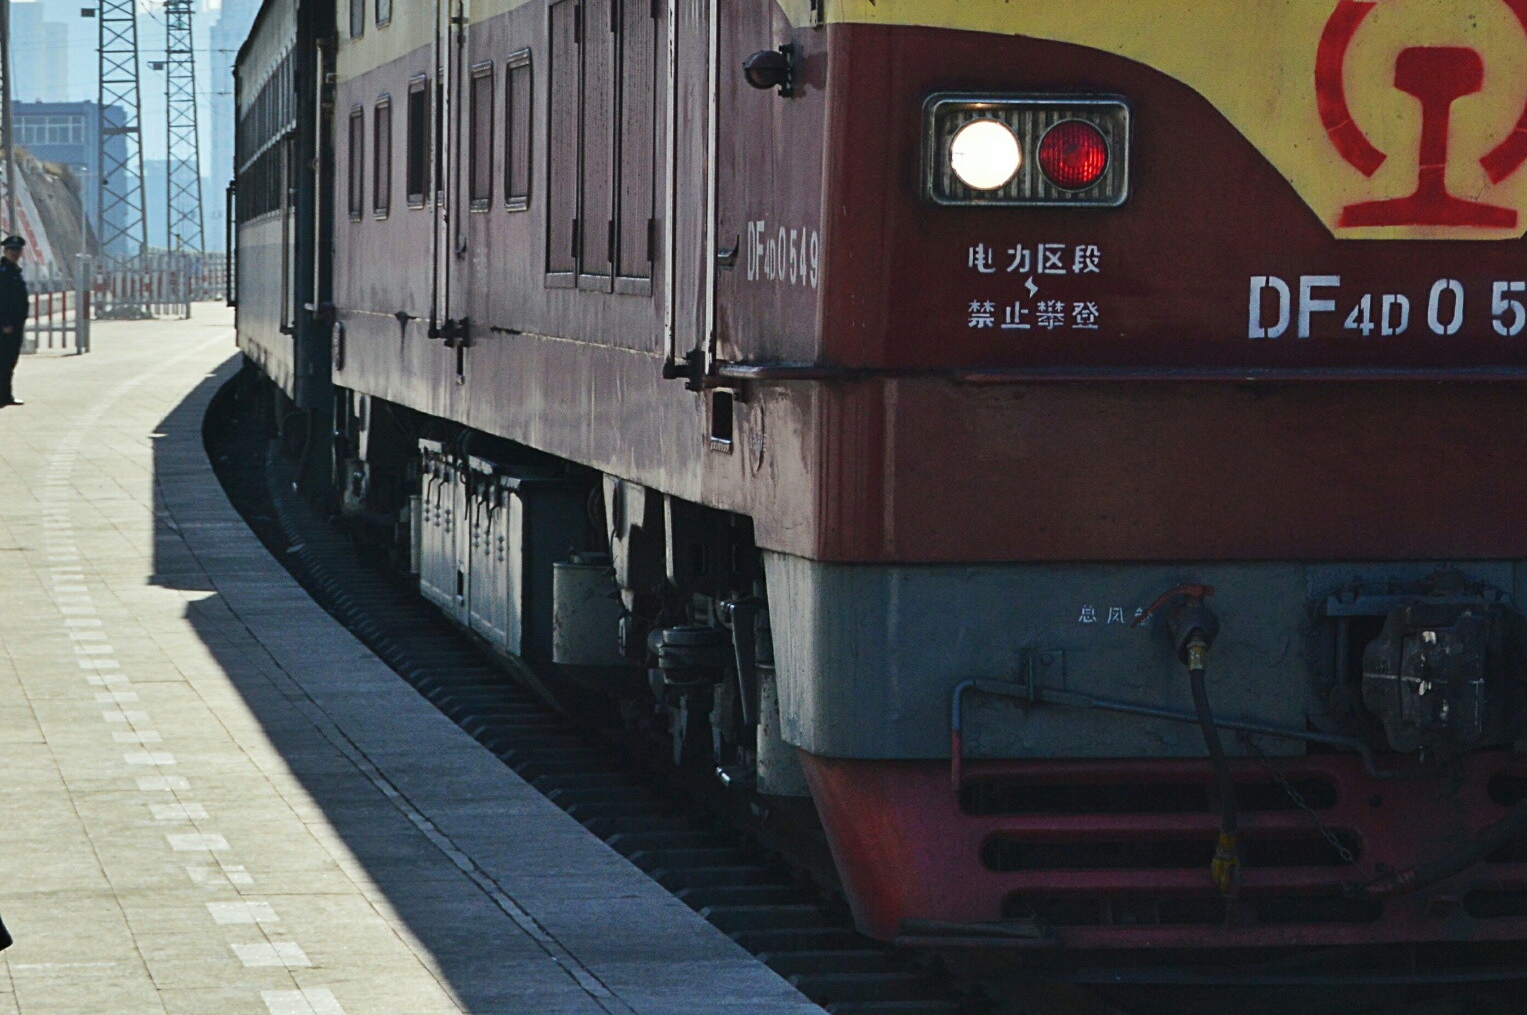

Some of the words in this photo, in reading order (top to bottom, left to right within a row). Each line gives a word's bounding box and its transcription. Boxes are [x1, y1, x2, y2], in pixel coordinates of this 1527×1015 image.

[968, 243, 1101, 274] 电力区段
[967, 299, 1100, 330] 禁止攀登
